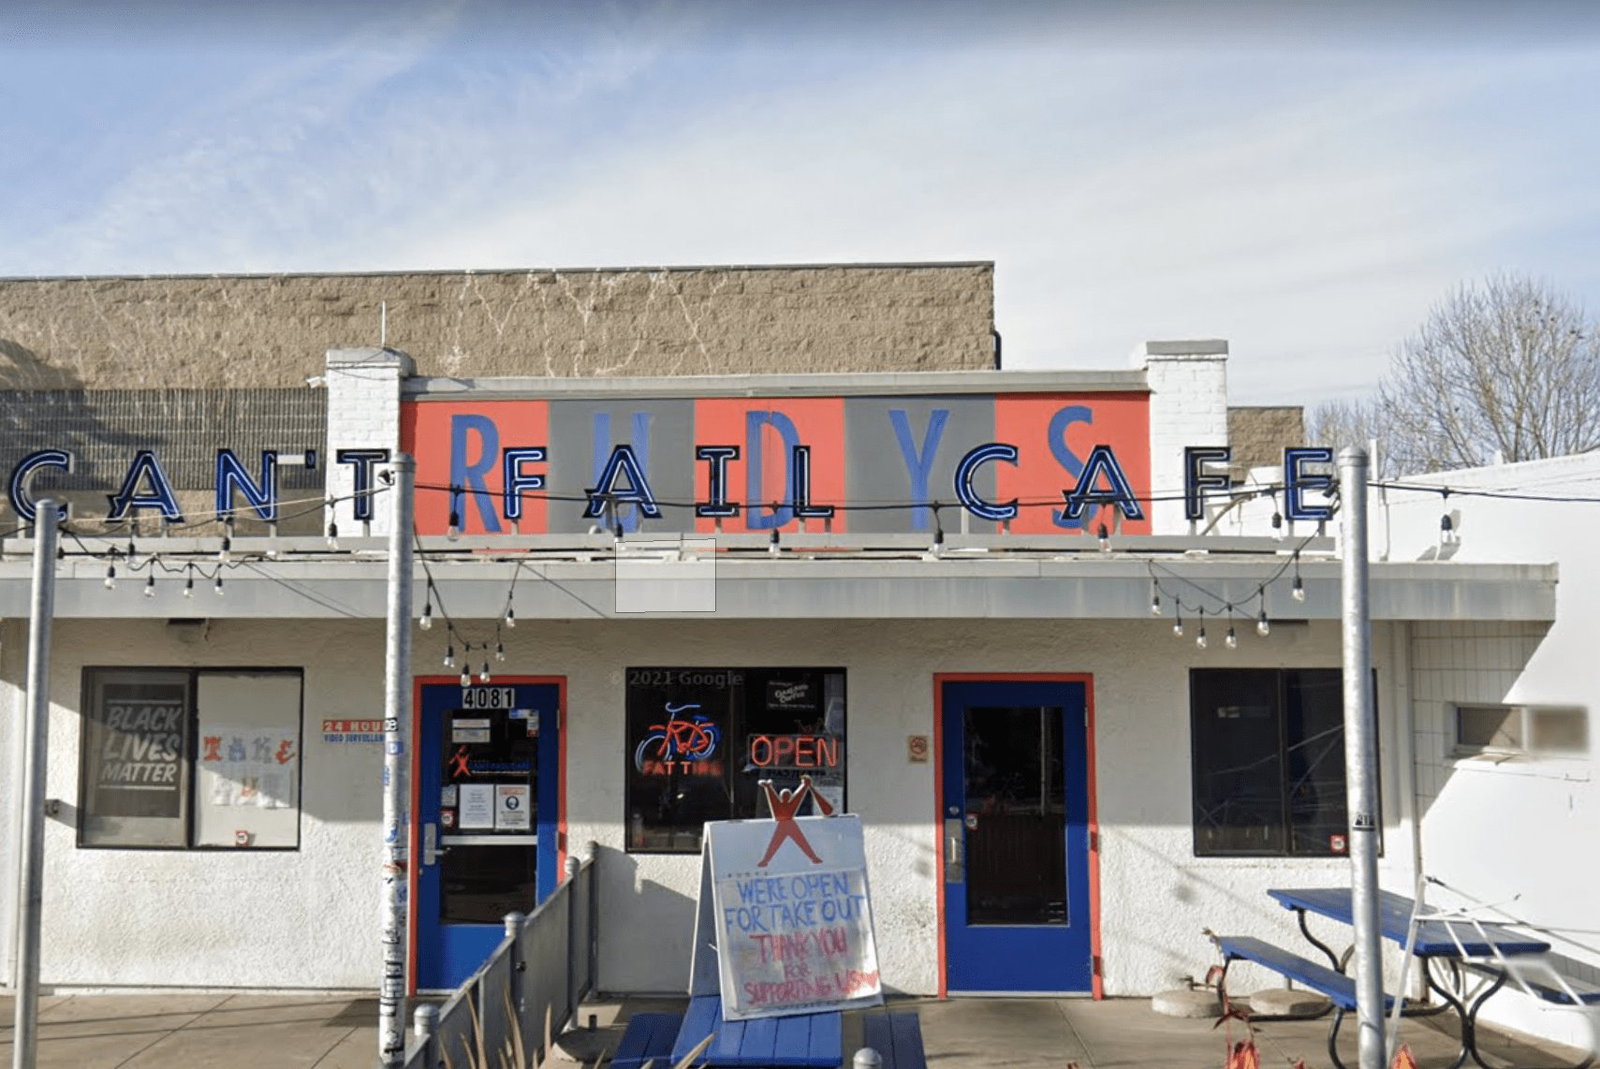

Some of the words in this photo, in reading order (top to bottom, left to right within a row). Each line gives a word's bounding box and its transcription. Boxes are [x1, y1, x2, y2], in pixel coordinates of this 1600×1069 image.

[8, 448, 391, 522] CAN'T
[503, 444, 835, 520] FAIL
[954, 443, 1334, 522] CAFE
[464, 689, 514, 708] 4081
[106, 706, 182, 732] BLACK
[350, 721, 386, 732] HOU
[102, 732, 180, 762] LIVES
[752, 736, 837, 767] OPEN
[100, 763, 178, 783] MATTER
[791, 871, 850, 901] OPEN
[725, 905, 769, 935] FOR
[767, 900, 818, 929] TAKE
[821, 894, 865, 923] OUT
[808, 925, 849, 958] YOU
